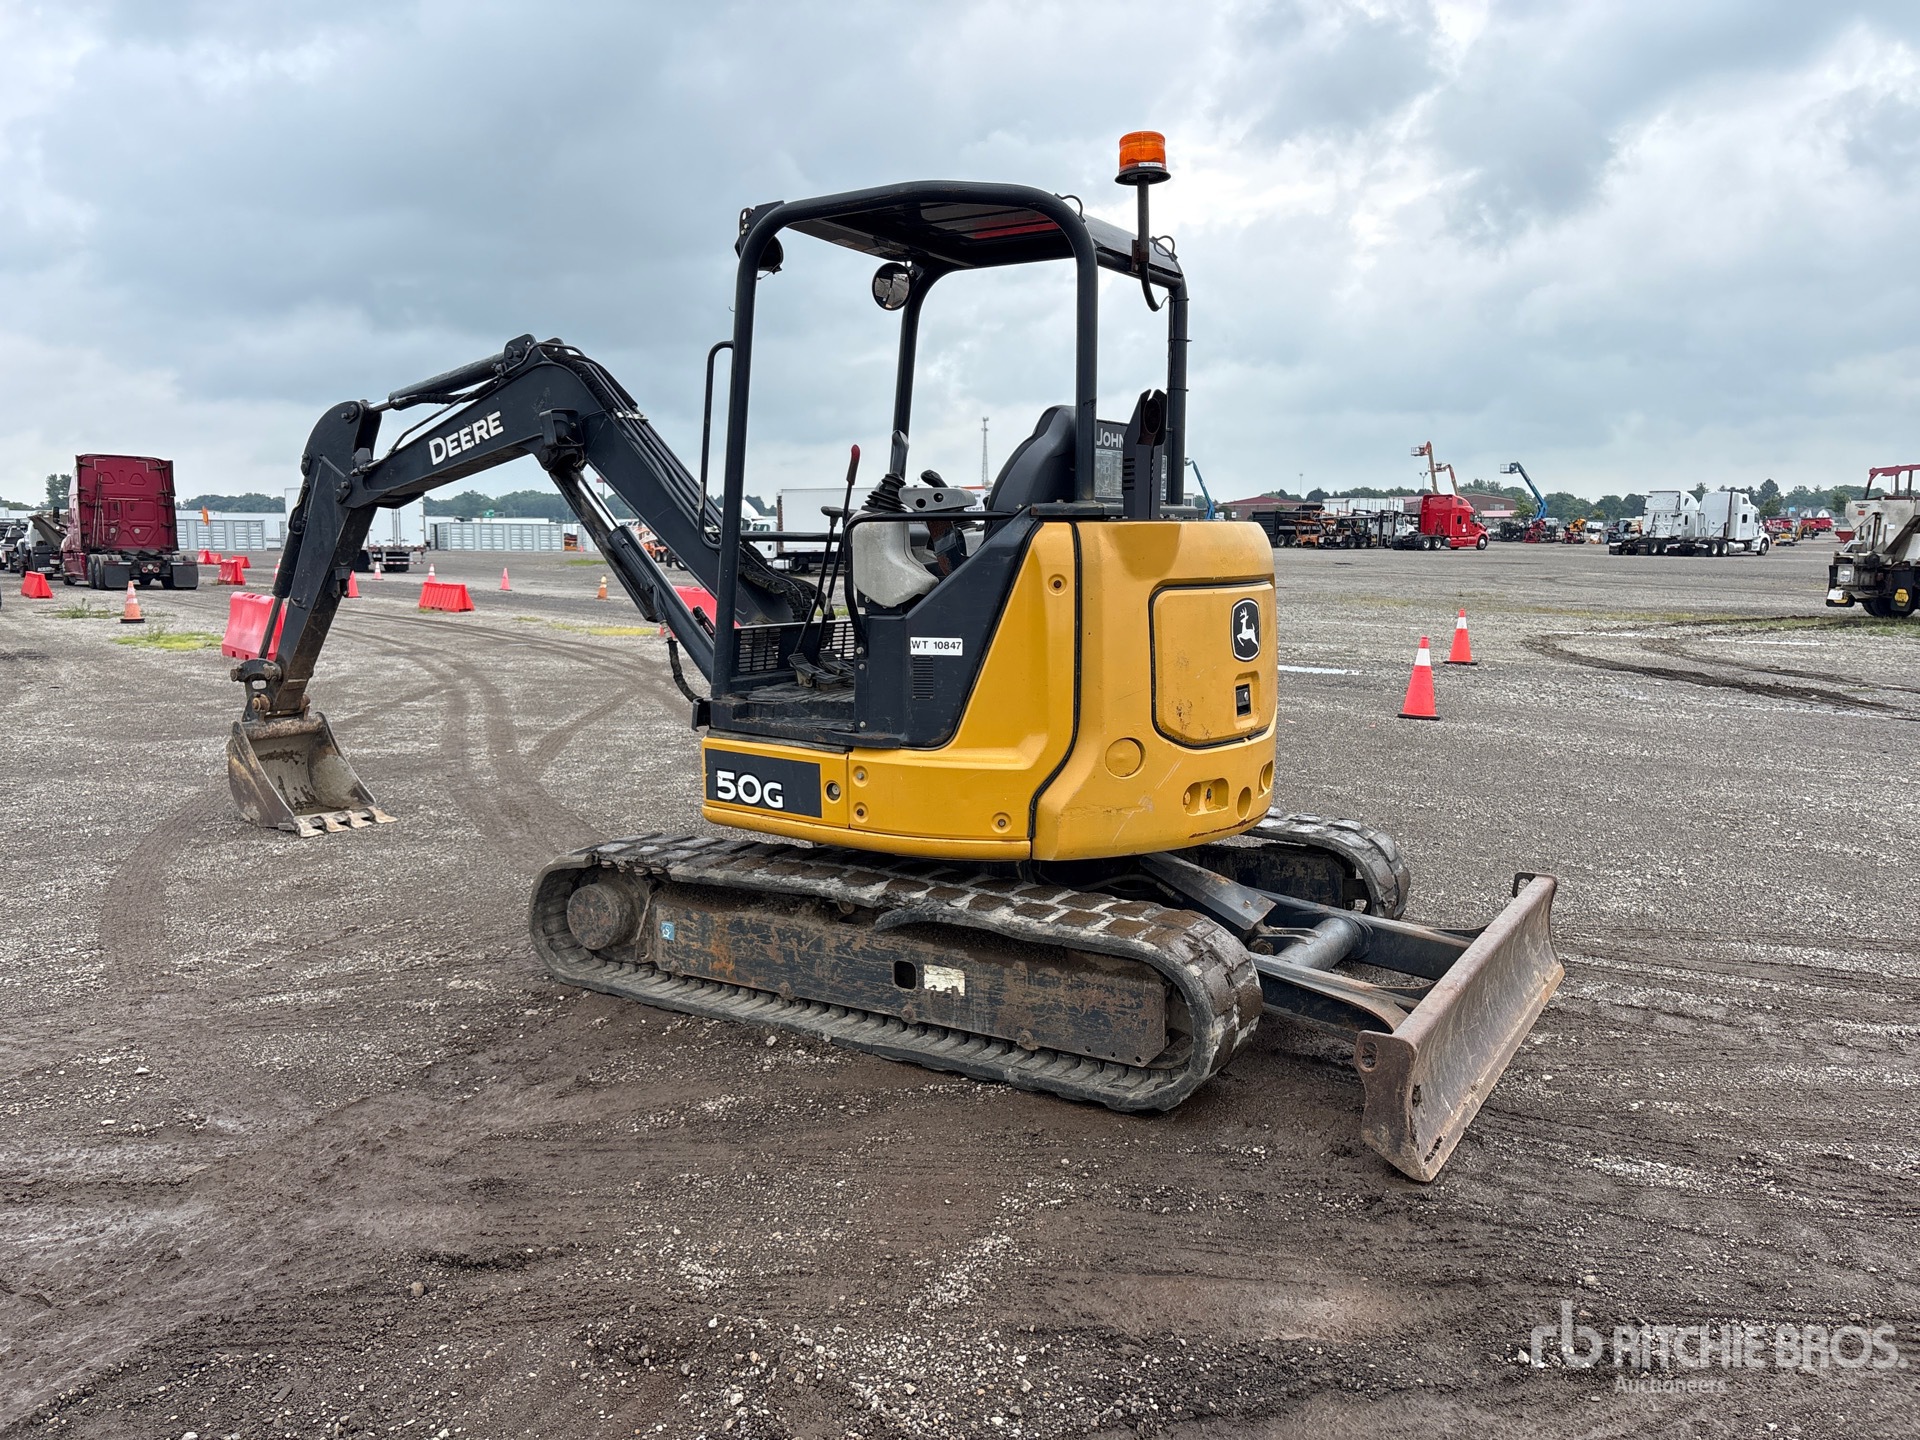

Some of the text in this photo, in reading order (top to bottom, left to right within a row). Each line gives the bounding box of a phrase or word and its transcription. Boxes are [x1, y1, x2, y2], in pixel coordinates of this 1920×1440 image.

[428, 410, 504, 466] DEERE
[911, 640, 962, 650] WT 10847
[716, 769, 784, 809] 50G
